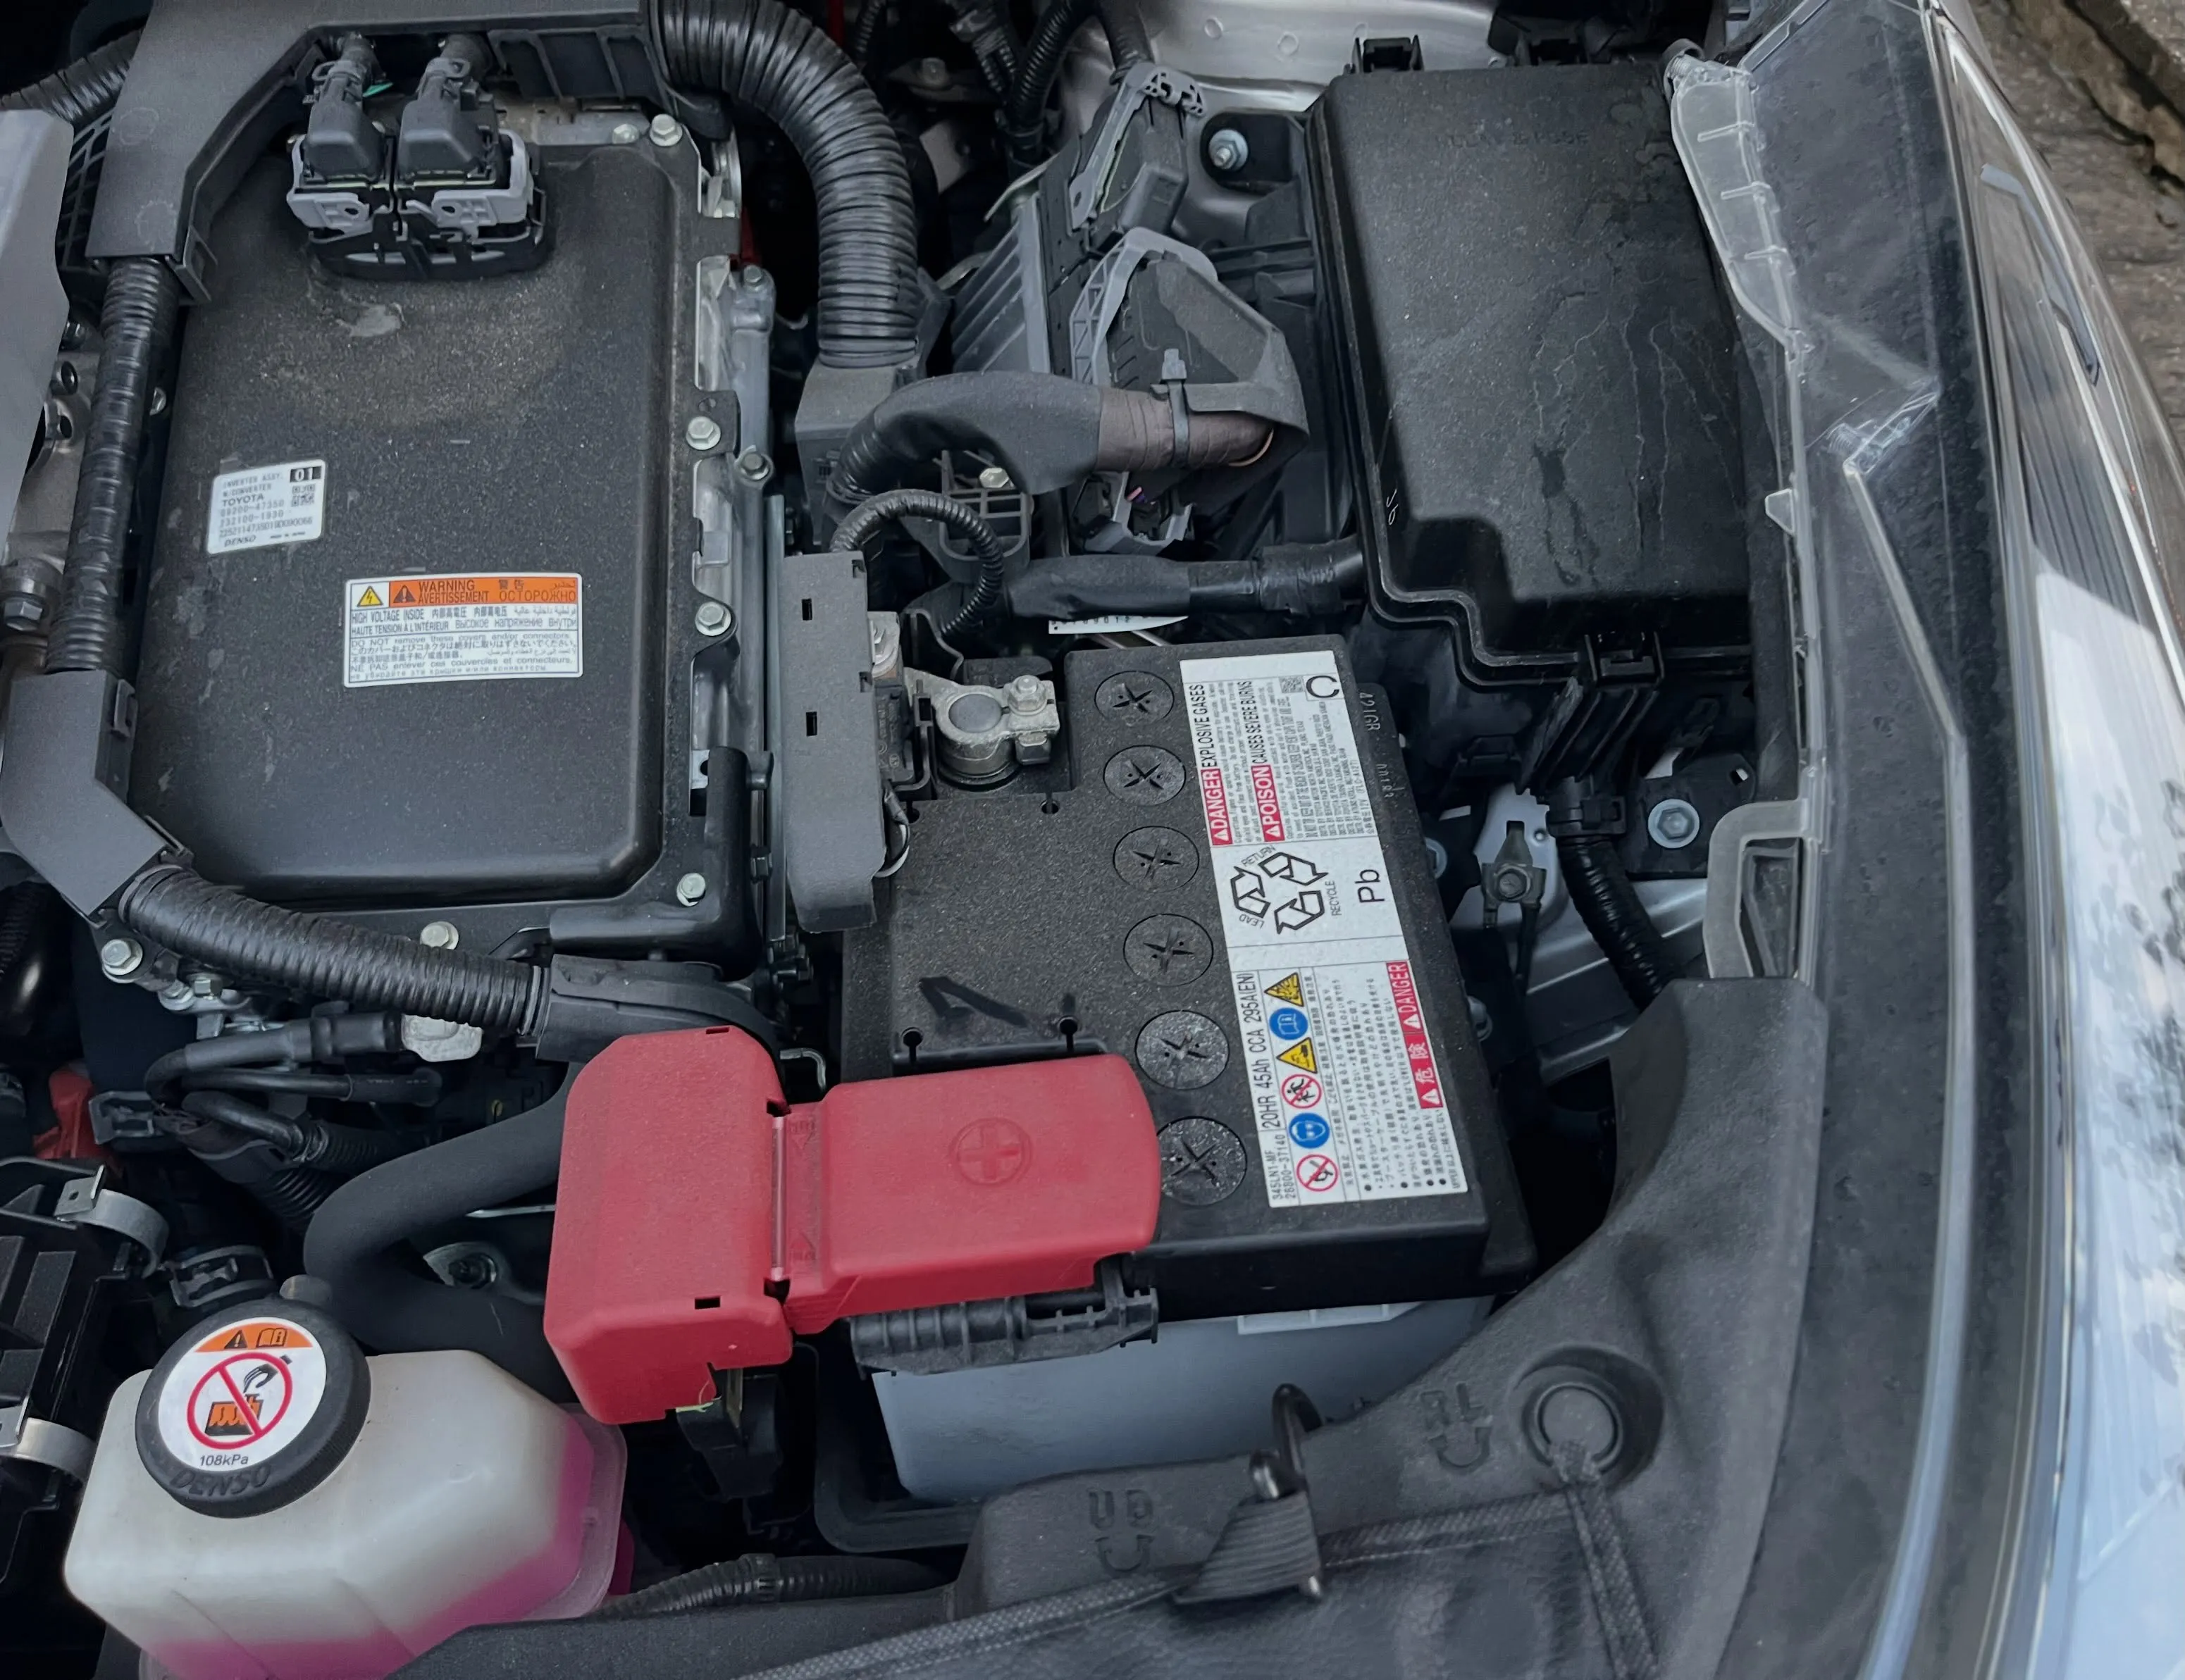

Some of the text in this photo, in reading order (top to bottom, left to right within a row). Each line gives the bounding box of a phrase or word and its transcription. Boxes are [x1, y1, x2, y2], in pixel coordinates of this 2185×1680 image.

[295, 468, 314, 482] 01
[222, 493, 264, 506] TOYOTA
[224, 535, 256, 547] DENSO
[419, 580, 475, 592] WARNING
[419, 590, 490, 604] AVERTISSEMENT
[499, 590, 576, 602] ОСТОРОЖНО
[352, 608, 425, 623] HIGH VOLTAGE INSIDE
[352, 626, 373, 636] HAUTE
[375, 624, 402, 635] TENSION
[352, 640, 366, 648] DO
[370, 637, 389, 646] NOT
[431, 634, 454, 642] these
[370, 663, 388, 671] PAS
[1188, 683, 1228, 828] DANGER EXPLOSIVE GASES
[1237, 680, 1280, 825] POISON CAUSES SEVERE BURNS
[1240, 845, 1276, 868] RETURN
[1354, 869, 1385, 903] Pb
[1325, 881, 1342, 916] RECYCLE
[1239, 914, 1265, 929] LEAD
[1387, 963, 1417, 1013] DANGER
[1235, 972, 1281, 1128] 20HR 45Ah CCA 295A(EN)
[199, 1453, 249, 1466] 108kPa
[168, 1464, 272, 1497] DENSO
